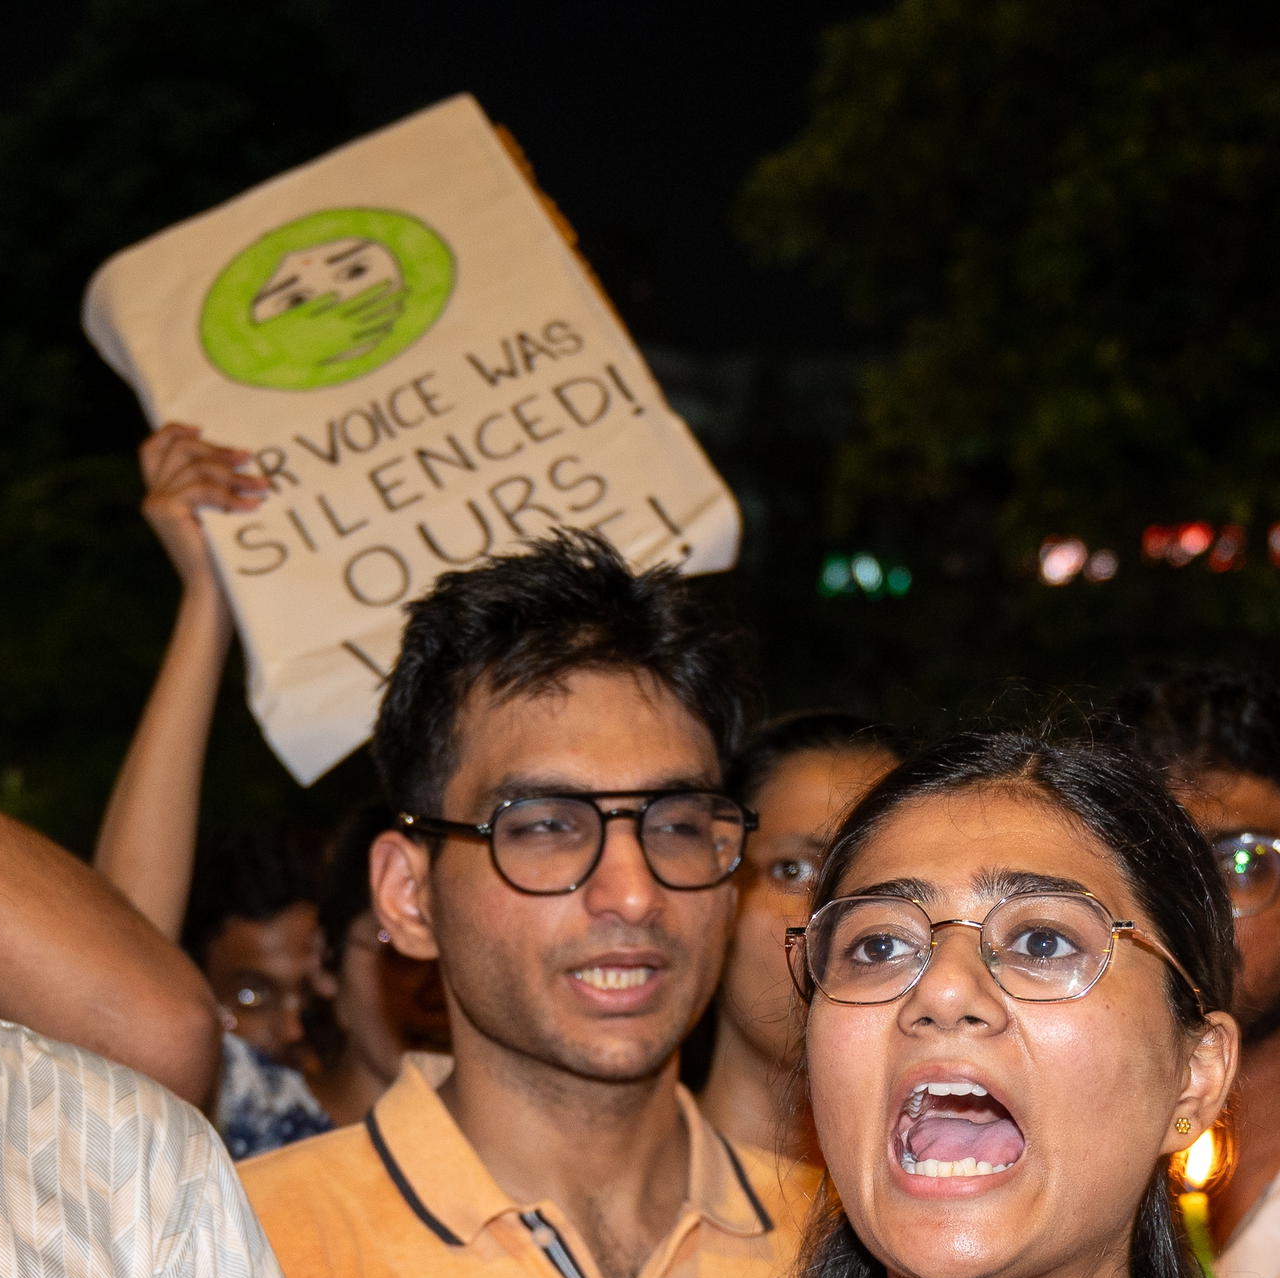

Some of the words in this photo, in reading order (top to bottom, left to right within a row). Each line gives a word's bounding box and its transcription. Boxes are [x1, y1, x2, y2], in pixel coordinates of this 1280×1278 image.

[234, 361, 646, 577] SILENCED!
[293, 370, 455, 467] VOICE
[465, 319, 586, 388] WAS
[343, 453, 609, 607] OURS
